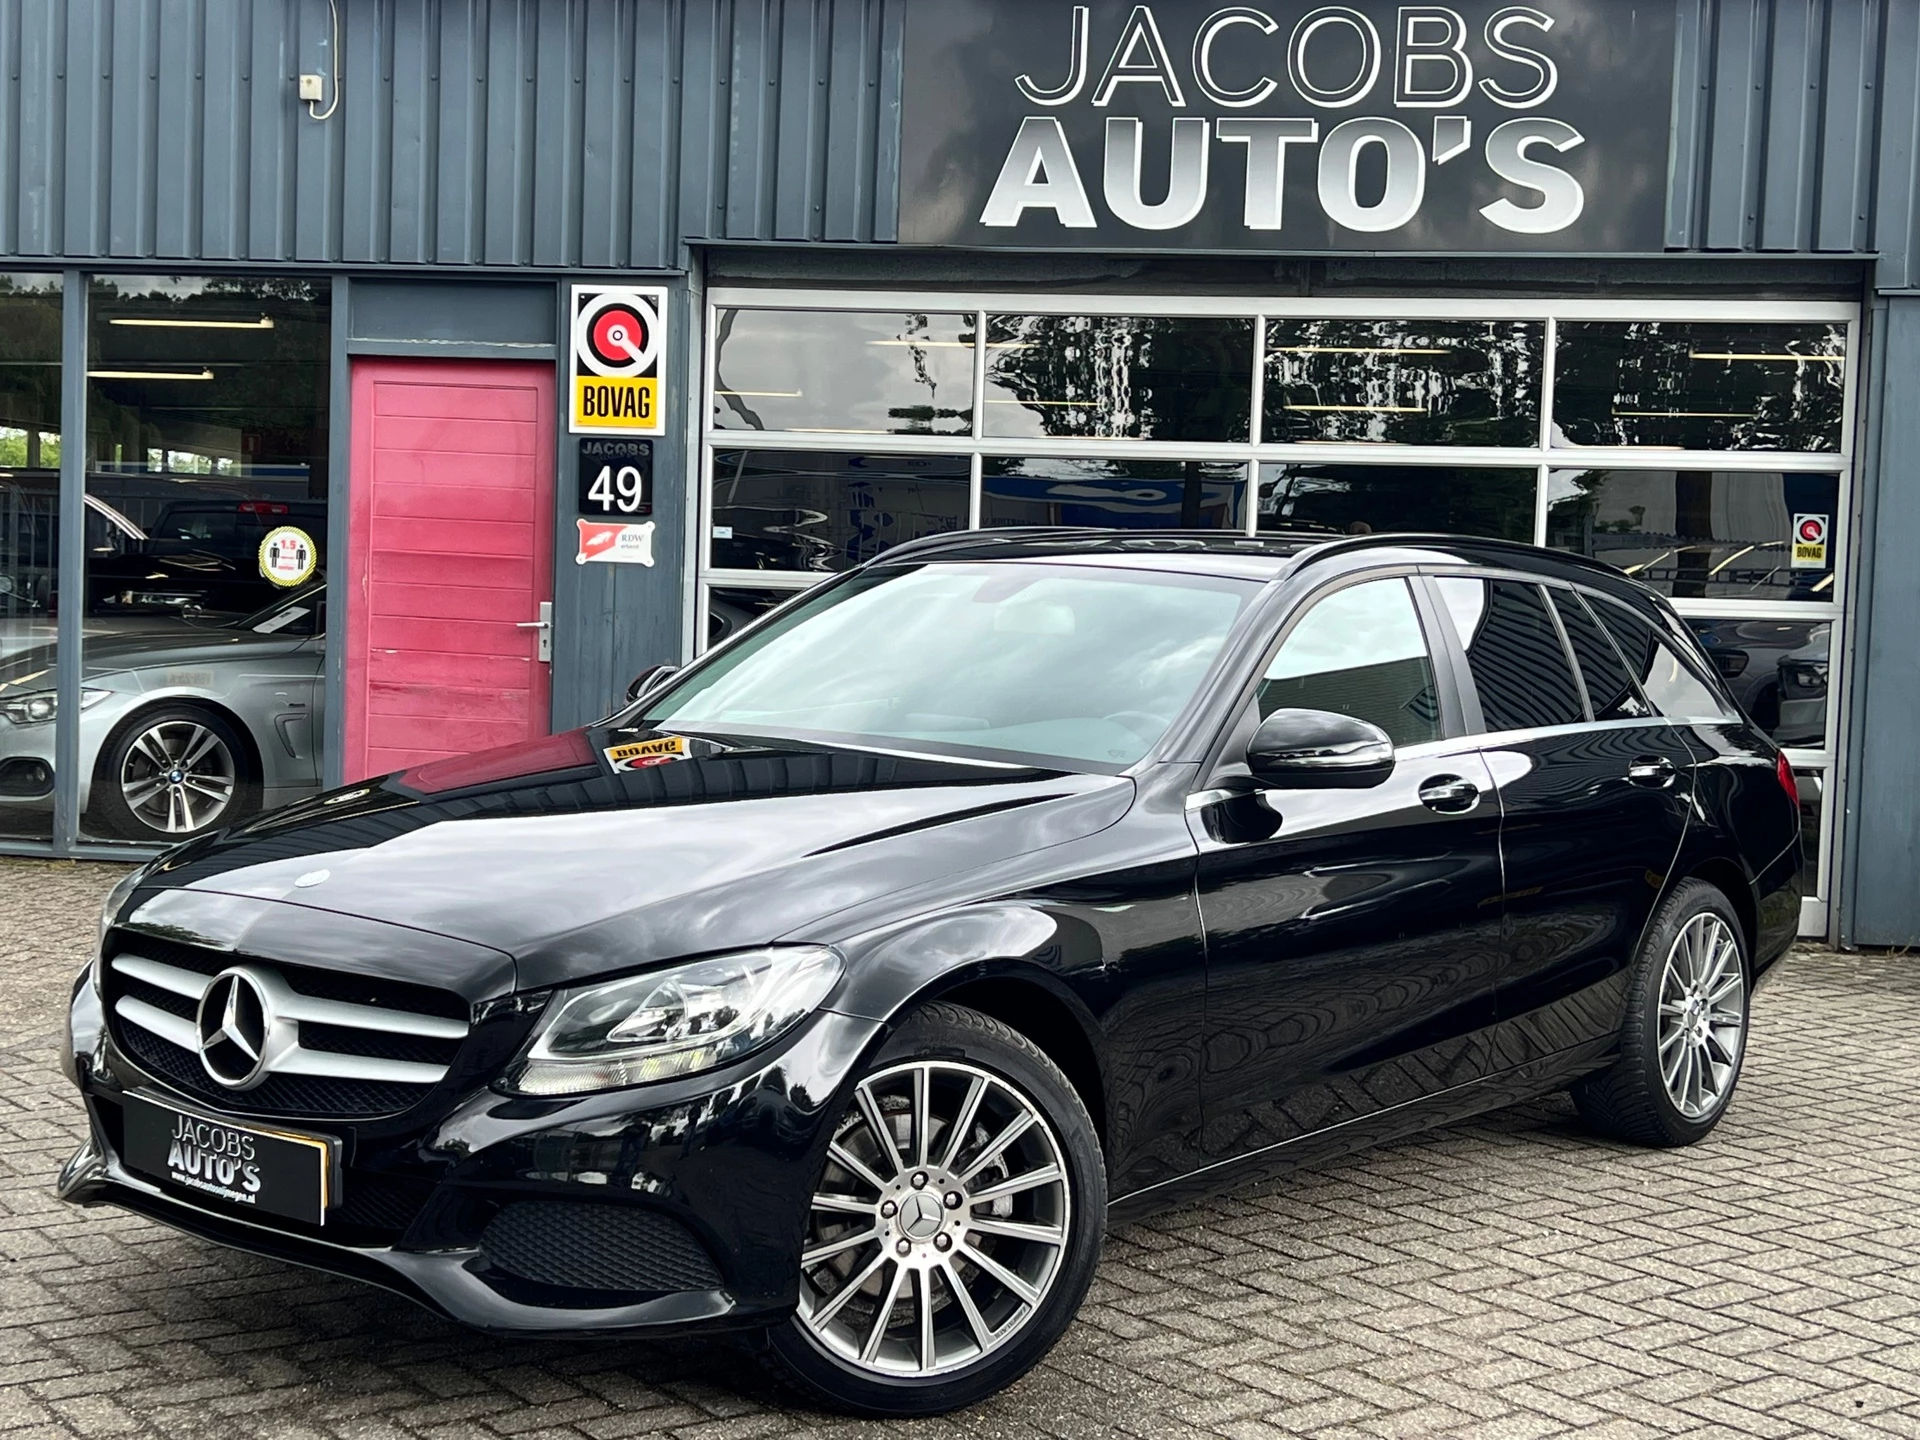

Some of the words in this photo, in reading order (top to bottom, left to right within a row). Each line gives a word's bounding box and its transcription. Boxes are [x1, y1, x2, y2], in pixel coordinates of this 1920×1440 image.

[1014, 5, 1558, 108] JACOBS
[979, 116, 1585, 233] AUTO'S
[584, 386, 650, 418] BOVAG
[583, 443, 649, 455] JACOBS
[588, 465, 642, 513] 49
[281, 539, 296, 550] 1.5
[621, 534, 644, 542] RDW
[1797, 547, 1822, 558] BOVAG
[171, 1115, 255, 1160] JACOBS
[167, 1139, 261, 1192] AUTO'S
